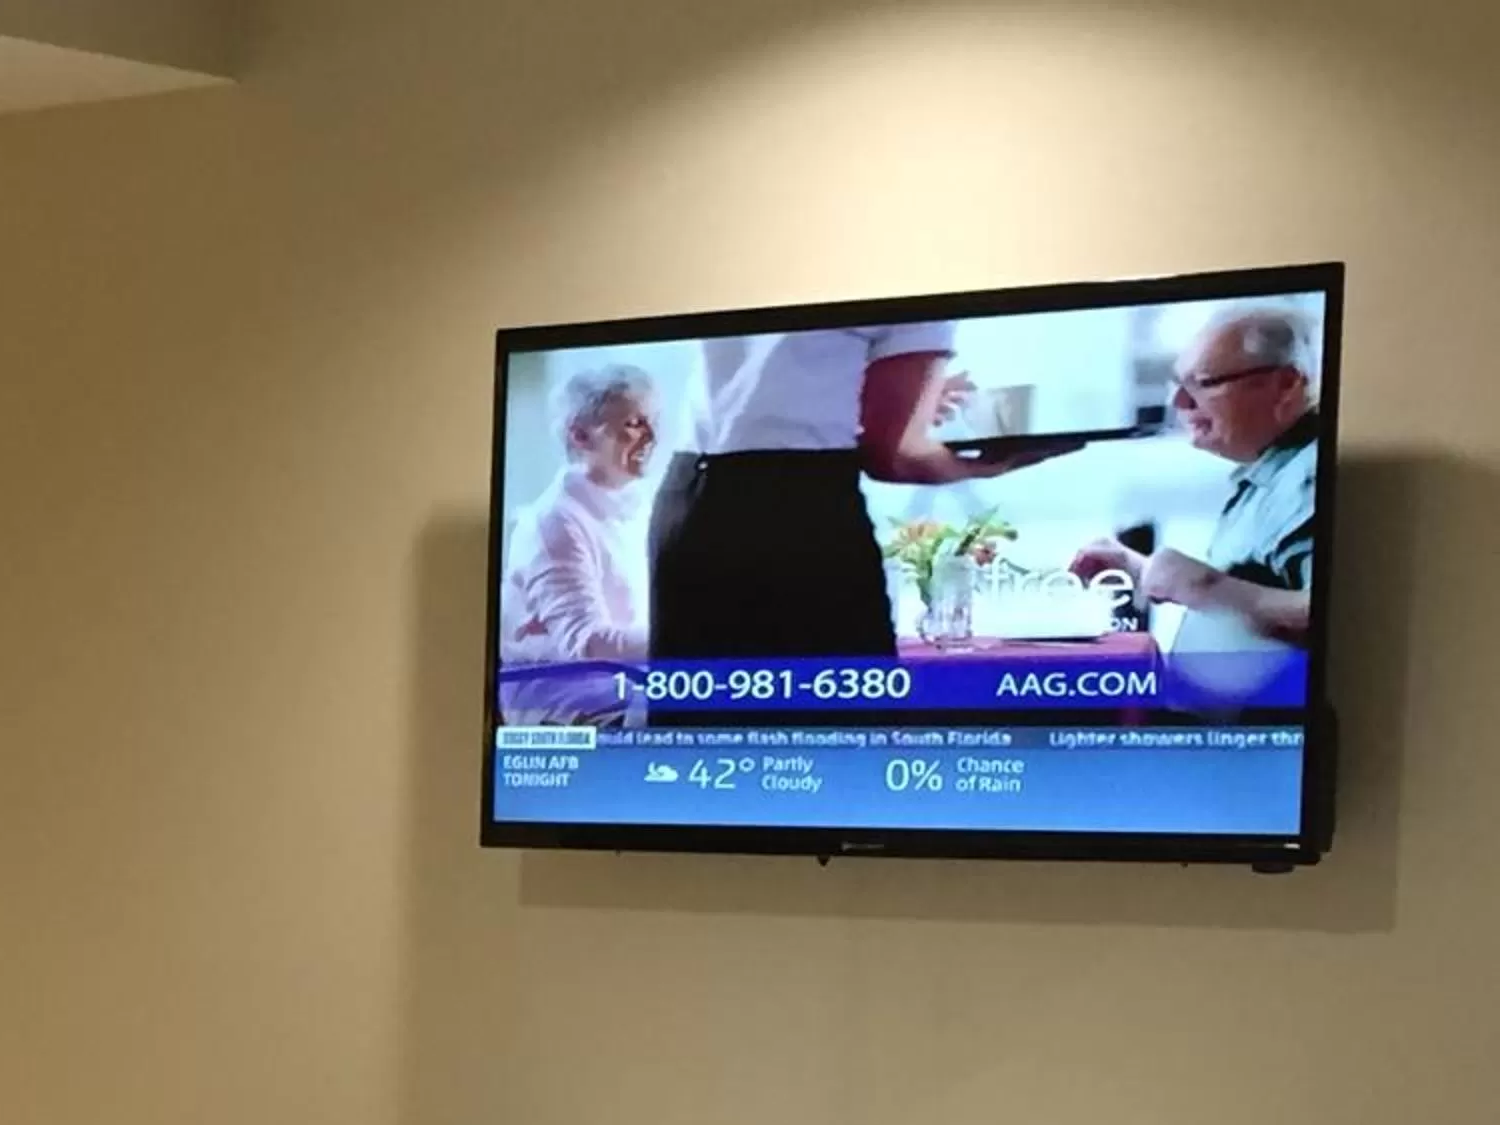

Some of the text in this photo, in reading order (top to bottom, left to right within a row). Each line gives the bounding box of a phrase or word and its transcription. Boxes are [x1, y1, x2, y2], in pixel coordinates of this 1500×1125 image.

[613, 668, 1158, 700] 1-800-981-6380 AAG.COM
[636, 731, 674, 746] lead
[676, 731, 694, 746] to
[698, 732, 743, 746] some
[747, 730, 789, 746] flash
[791, 730, 867, 749] flooding
[870, 730, 888, 746] in
[891, 730, 944, 746] South
[947, 730, 1013, 746] Florida
[1049, 731, 1116, 749] Lighter
[1120, 731, 1204, 747] showers
[1207, 731, 1267, 749] linger
[502, 755, 579, 770] EGLIN AFB
[762, 755, 814, 773] Partly
[956, 756, 1025, 773] Chance
[503, 771, 571, 787] TONIGHT
[687, 756, 757, 790] 42°
[885, 759, 943, 792] 0%
[761, 774, 823, 793] Cloudy
[955, 774, 1022, 792] of Rain
